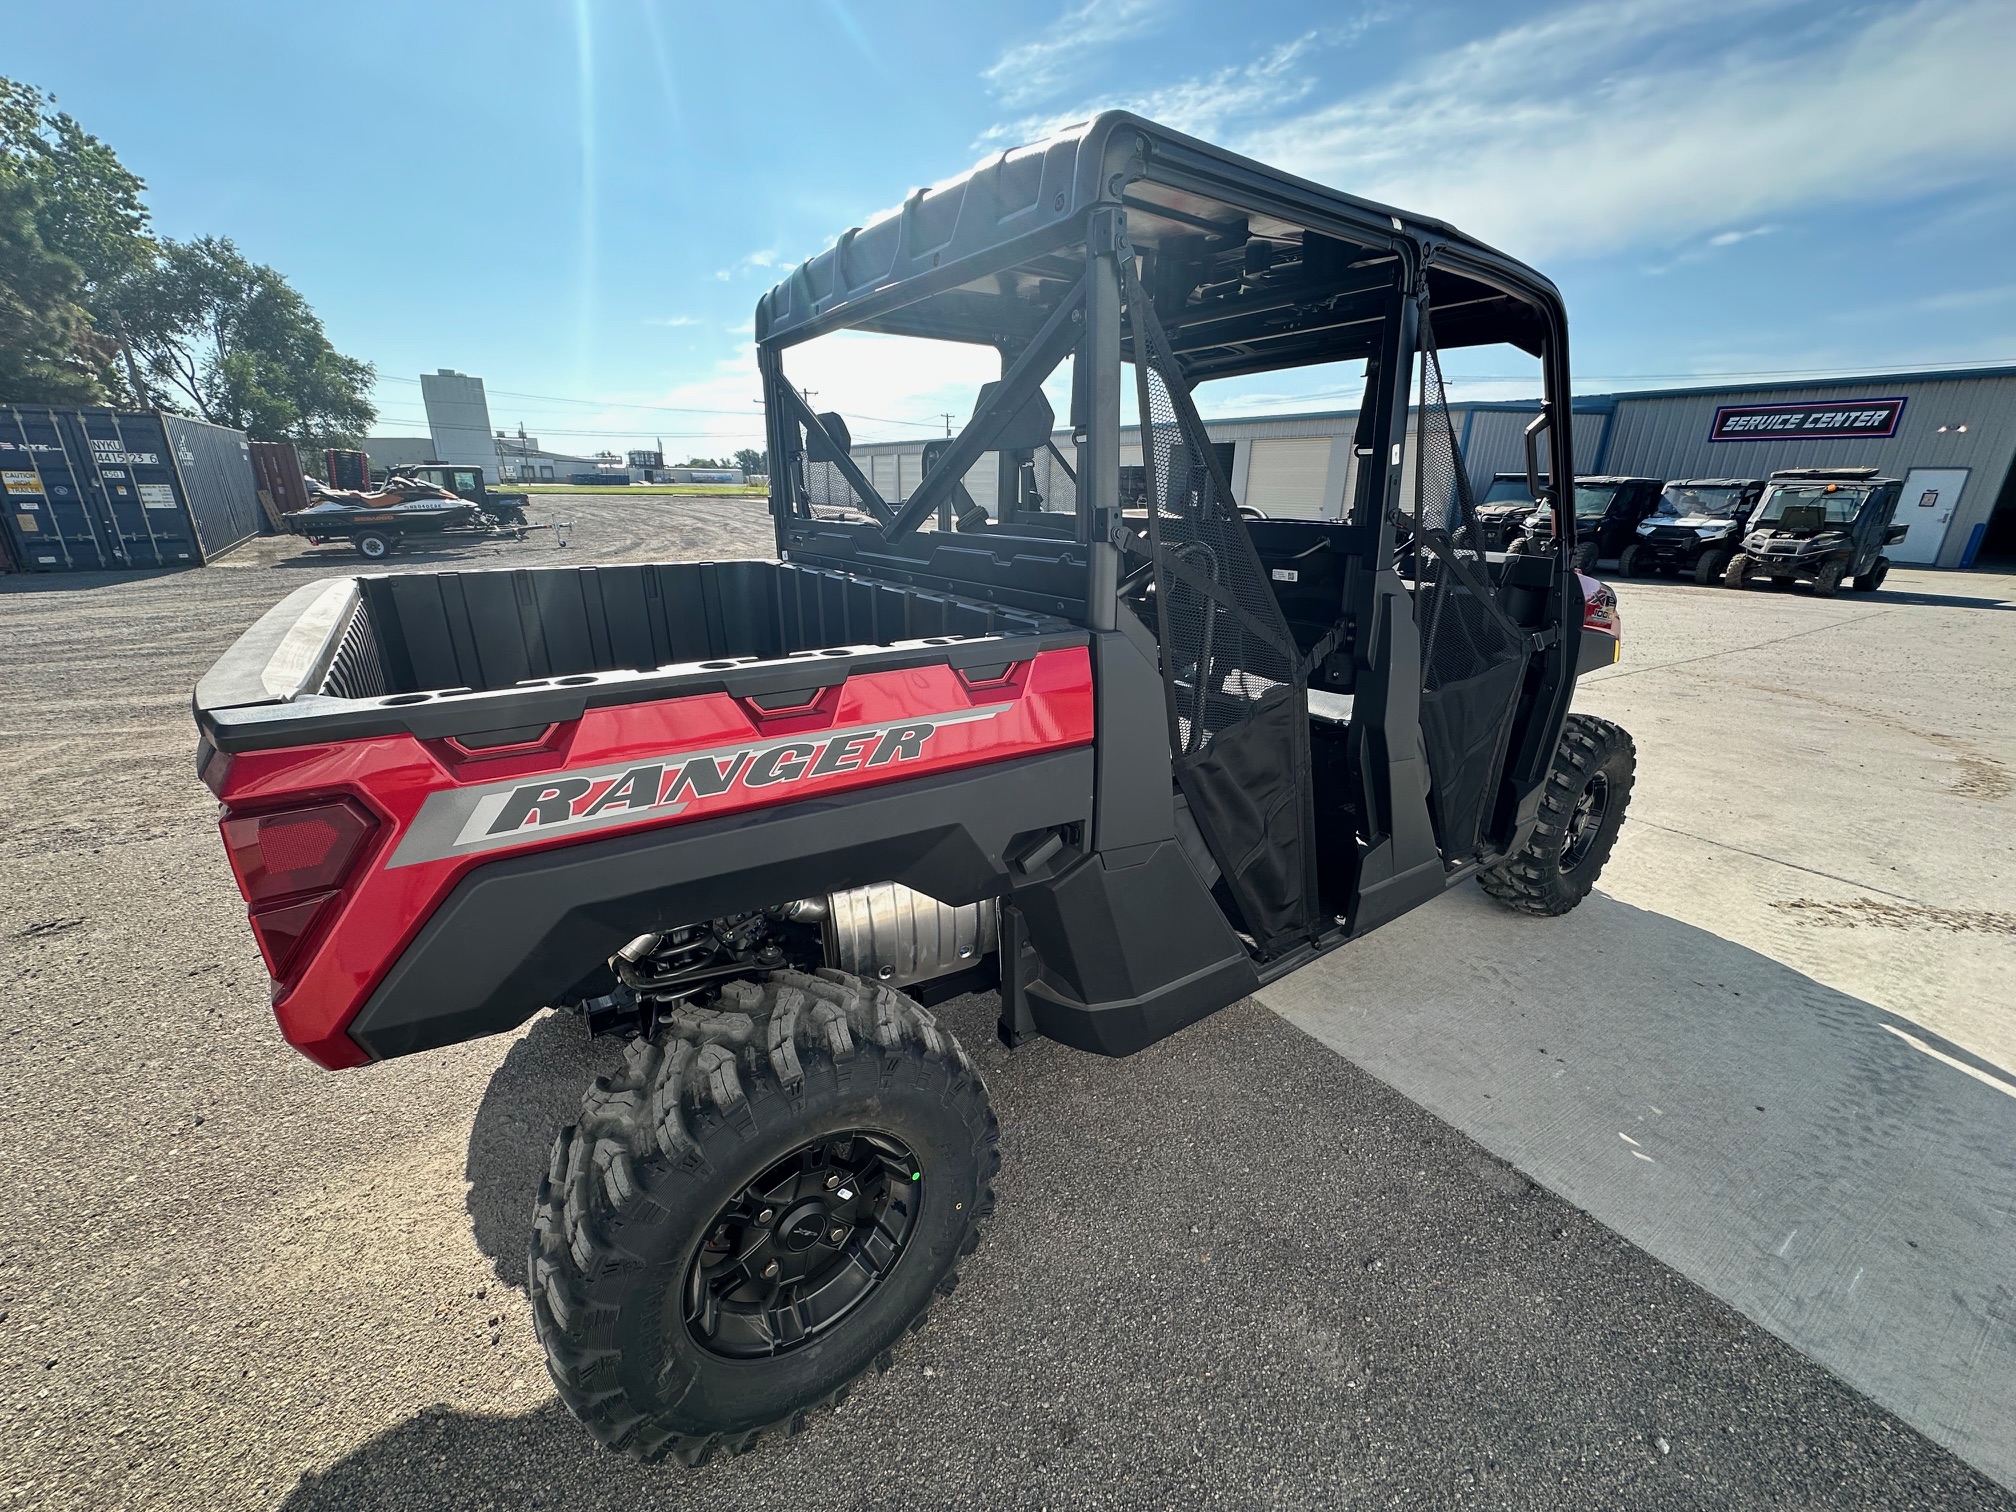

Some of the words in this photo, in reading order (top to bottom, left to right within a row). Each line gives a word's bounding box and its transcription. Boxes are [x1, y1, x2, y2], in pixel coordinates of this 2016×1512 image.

[1722, 413, 1805, 431] SERVICE
[1802, 410, 1890, 429] CENTER
[92, 441, 121, 450] NYKU
[1591, 592, 1616, 607] XP
[485, 723, 936, 836] RANGER
